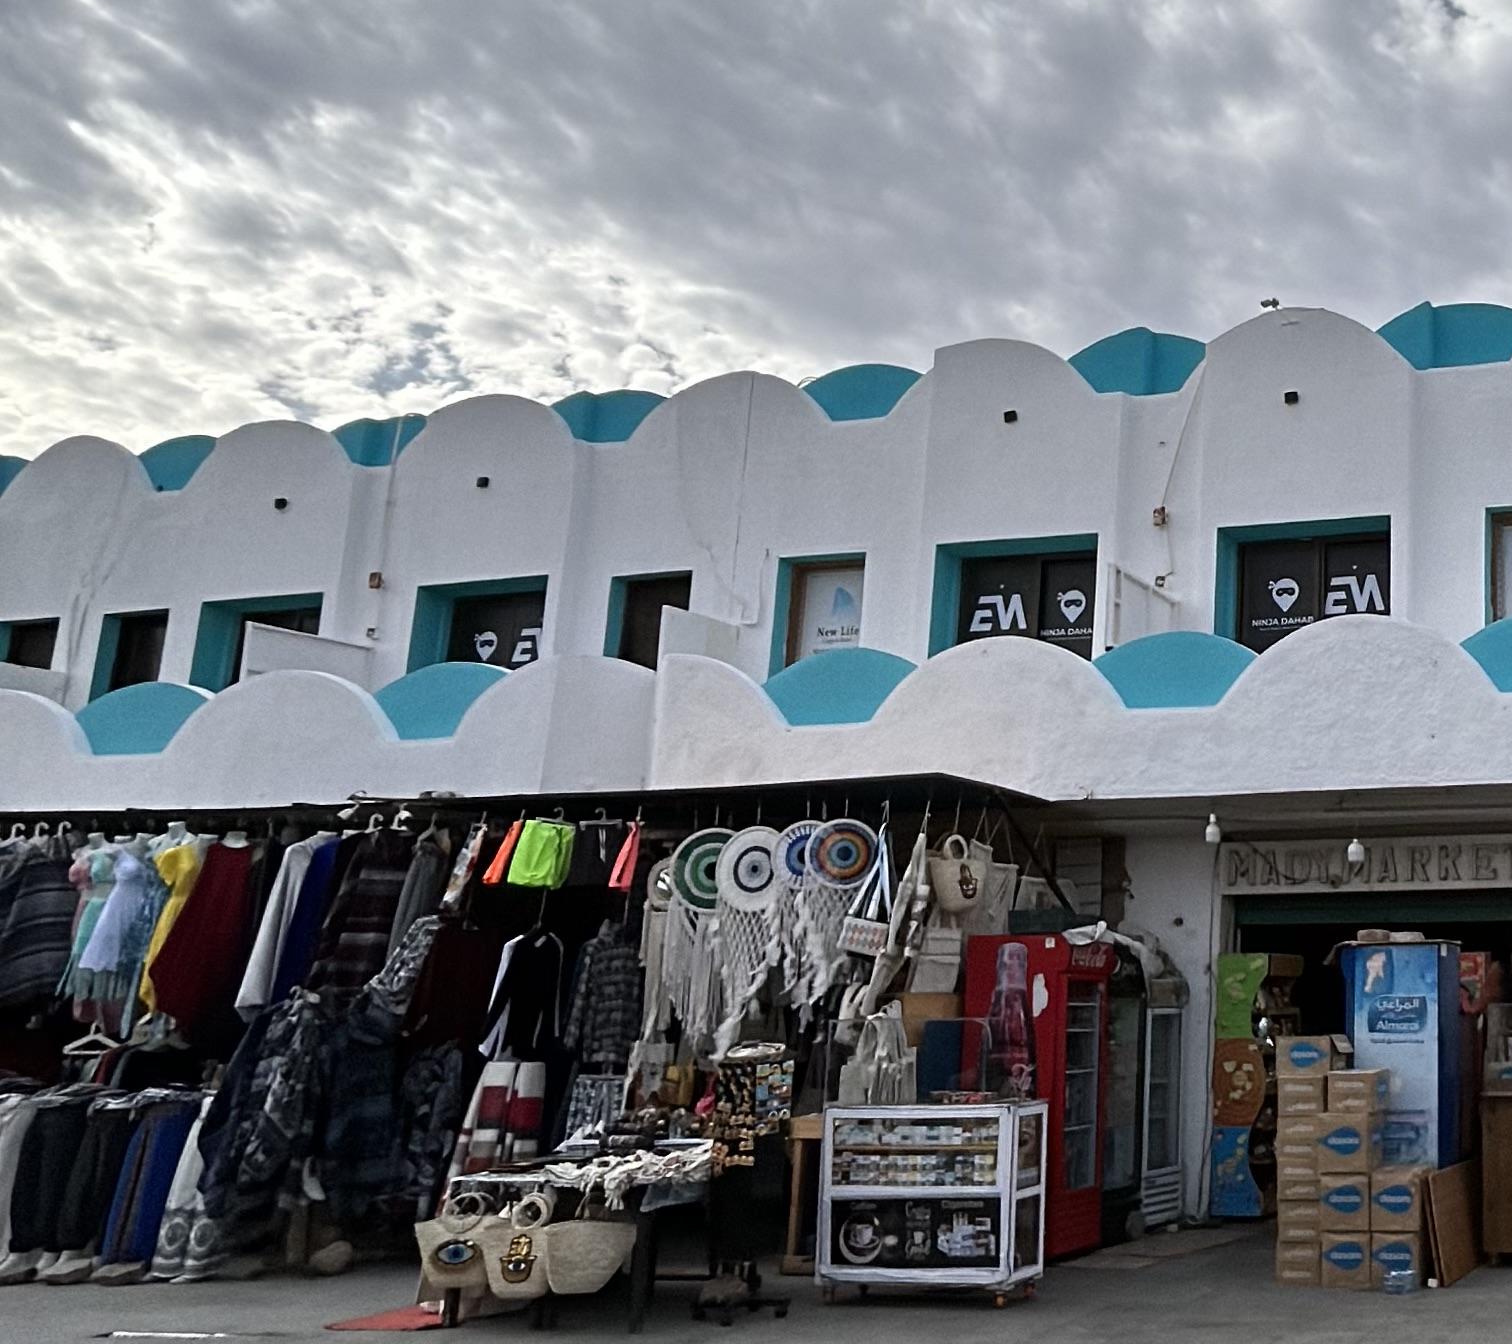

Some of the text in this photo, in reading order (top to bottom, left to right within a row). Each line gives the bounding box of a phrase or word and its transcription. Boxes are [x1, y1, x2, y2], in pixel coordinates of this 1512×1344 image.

[1252, 618, 1279, 627] NINJA
[817, 625, 860, 636] New Life
[1067, 627, 1093, 635] DAHA
